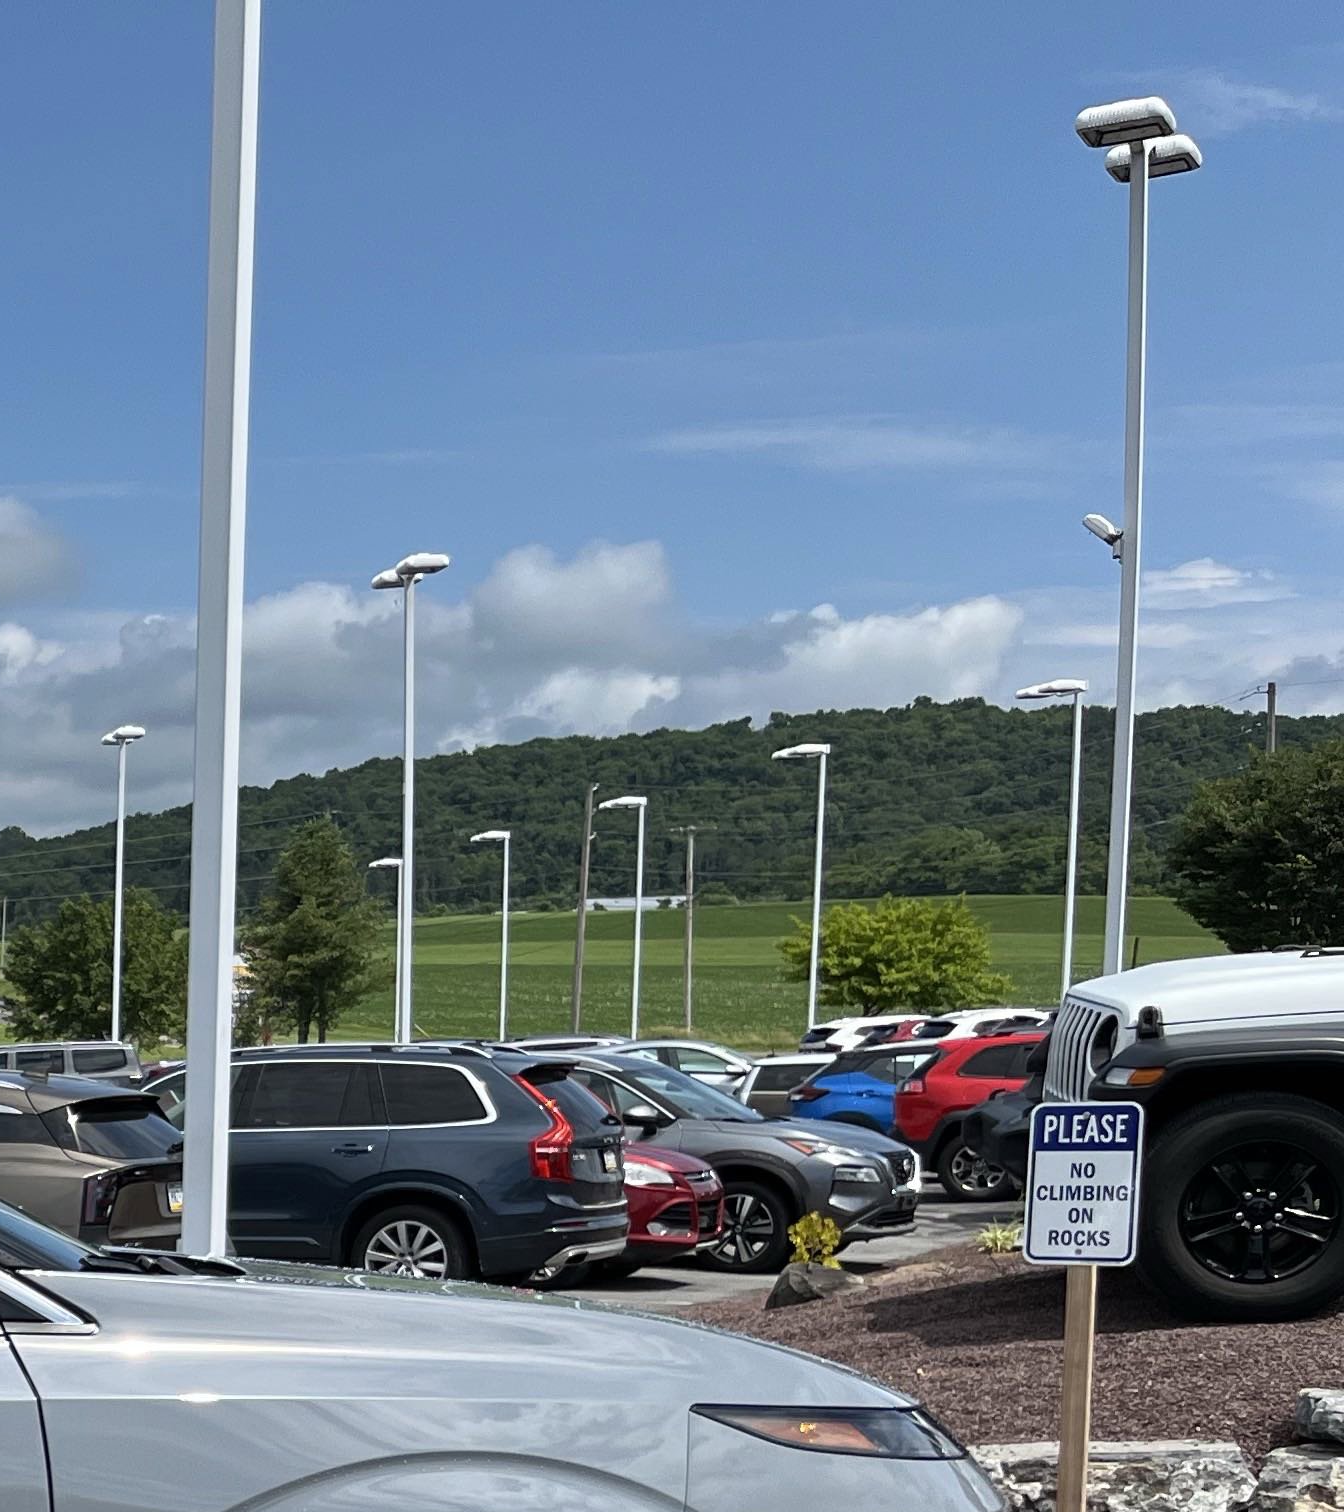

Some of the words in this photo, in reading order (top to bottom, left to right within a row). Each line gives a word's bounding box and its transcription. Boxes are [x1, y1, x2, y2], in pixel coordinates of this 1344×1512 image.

[1043, 1113, 1129, 1144] PLEASE
[1070, 1162, 1096, 1179] NO
[1036, 1185, 1129, 1202] CLIMBING
[1068, 1207, 1094, 1224] ON
[1047, 1229, 1111, 1247] ROCKS
